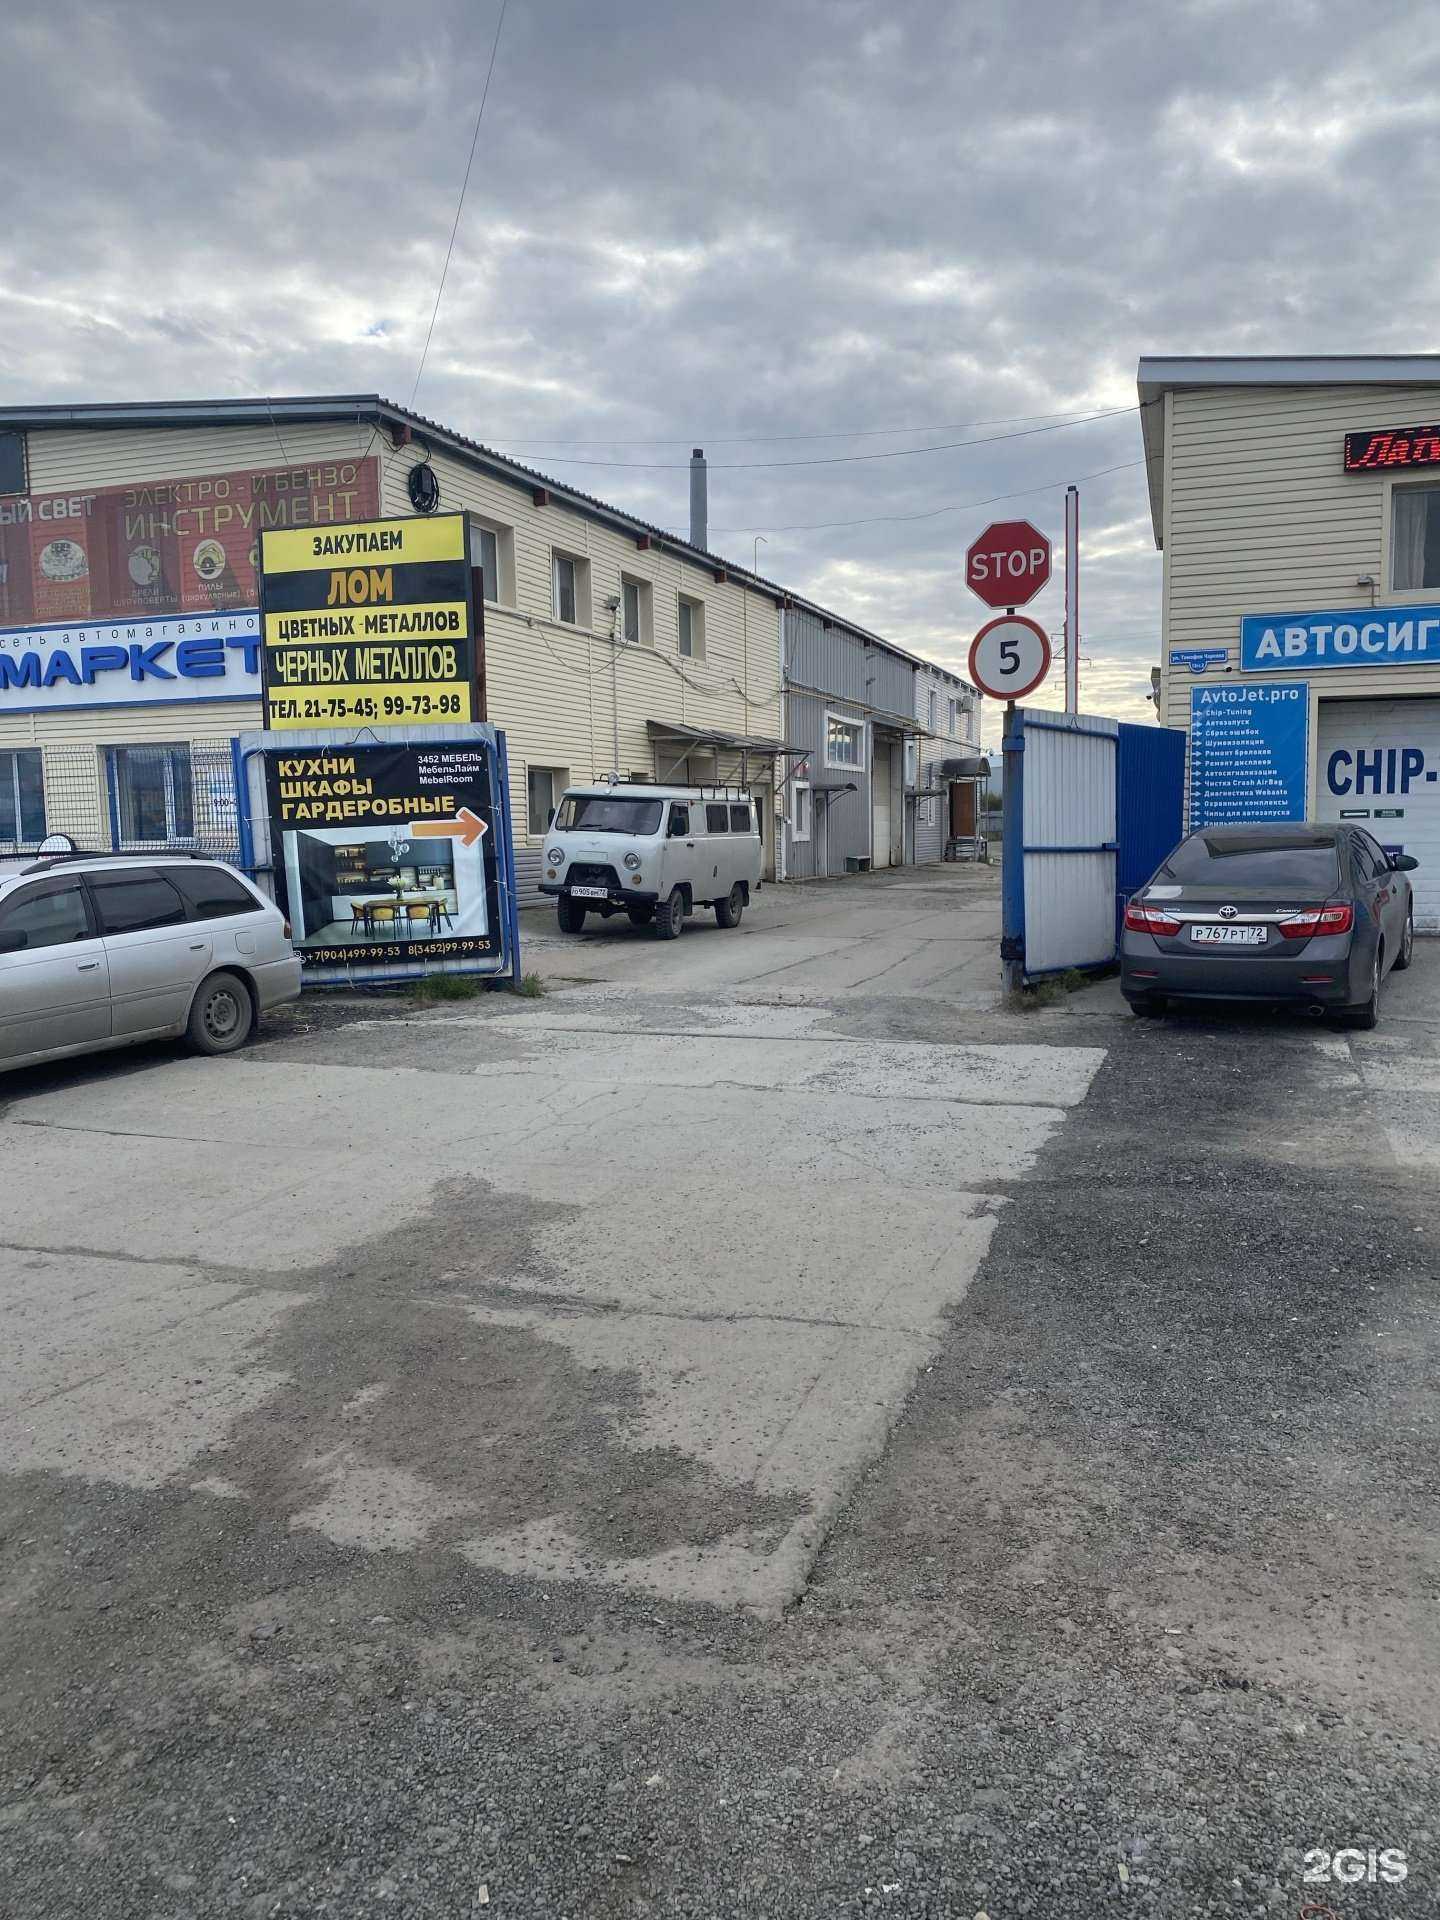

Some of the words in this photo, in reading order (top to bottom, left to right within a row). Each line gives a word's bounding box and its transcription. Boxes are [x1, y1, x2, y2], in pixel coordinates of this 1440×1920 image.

[125, 479, 230, 508] ЭЛЕКТРО
[252, 474, 267, 494] И
[275, 465, 357, 492] БЕНЗО
[39, 495, 97, 521] СВЕТ
[126, 491, 359, 540] ИНСТРУМЕНТ
[313, 530, 402, 556] ЗАКУПАЕМ
[971, 548, 1045, 580] STOP
[327, 568, 393, 605] ЛОМ
[278, 615, 355, 641] ЦВЕТНЫХ
[364, 611, 460, 634] МЕТАЛЛОВ
[0, 635, 46, 648] сеть
[0, 635, 260, 690] МАРКЕТ
[276, 649, 349, 683] ЧЕРНЫХ
[355, 645, 457, 680] МЕТАЛЛОВ
[999, 640, 1021, 675] 5
[269, 699, 302, 719] ТЕЛ.
[304, 699, 378, 720] 21-75-45;
[384, 694, 461, 715] 99-73-98
[1201, 688, 1298, 704] AvtoJet.pro
[1205, 709, 1252, 717] Chip-Tuning
[1205, 719, 1250, 727] Автозапуск
[278, 758, 355, 777] КУХНИ
[417, 755, 439, 764] 3452
[441, 753, 482, 764] МЕБЕЛЬ
[418, 764, 480, 775] МебельЛайм
[280, 778, 373, 798] ШКАФЫ
[419, 775, 473, 785] MebelRoom
[1256, 778, 1283, 787] AirBag
[282, 796, 455, 821] ГАРДЕРОБНЫЕ
[1244, 799, 1289, 807] комплексы
[307, 947, 400, 963] +7(904)499-99-53
[408, 941, 491, 956] 8(3452)99-99-53
